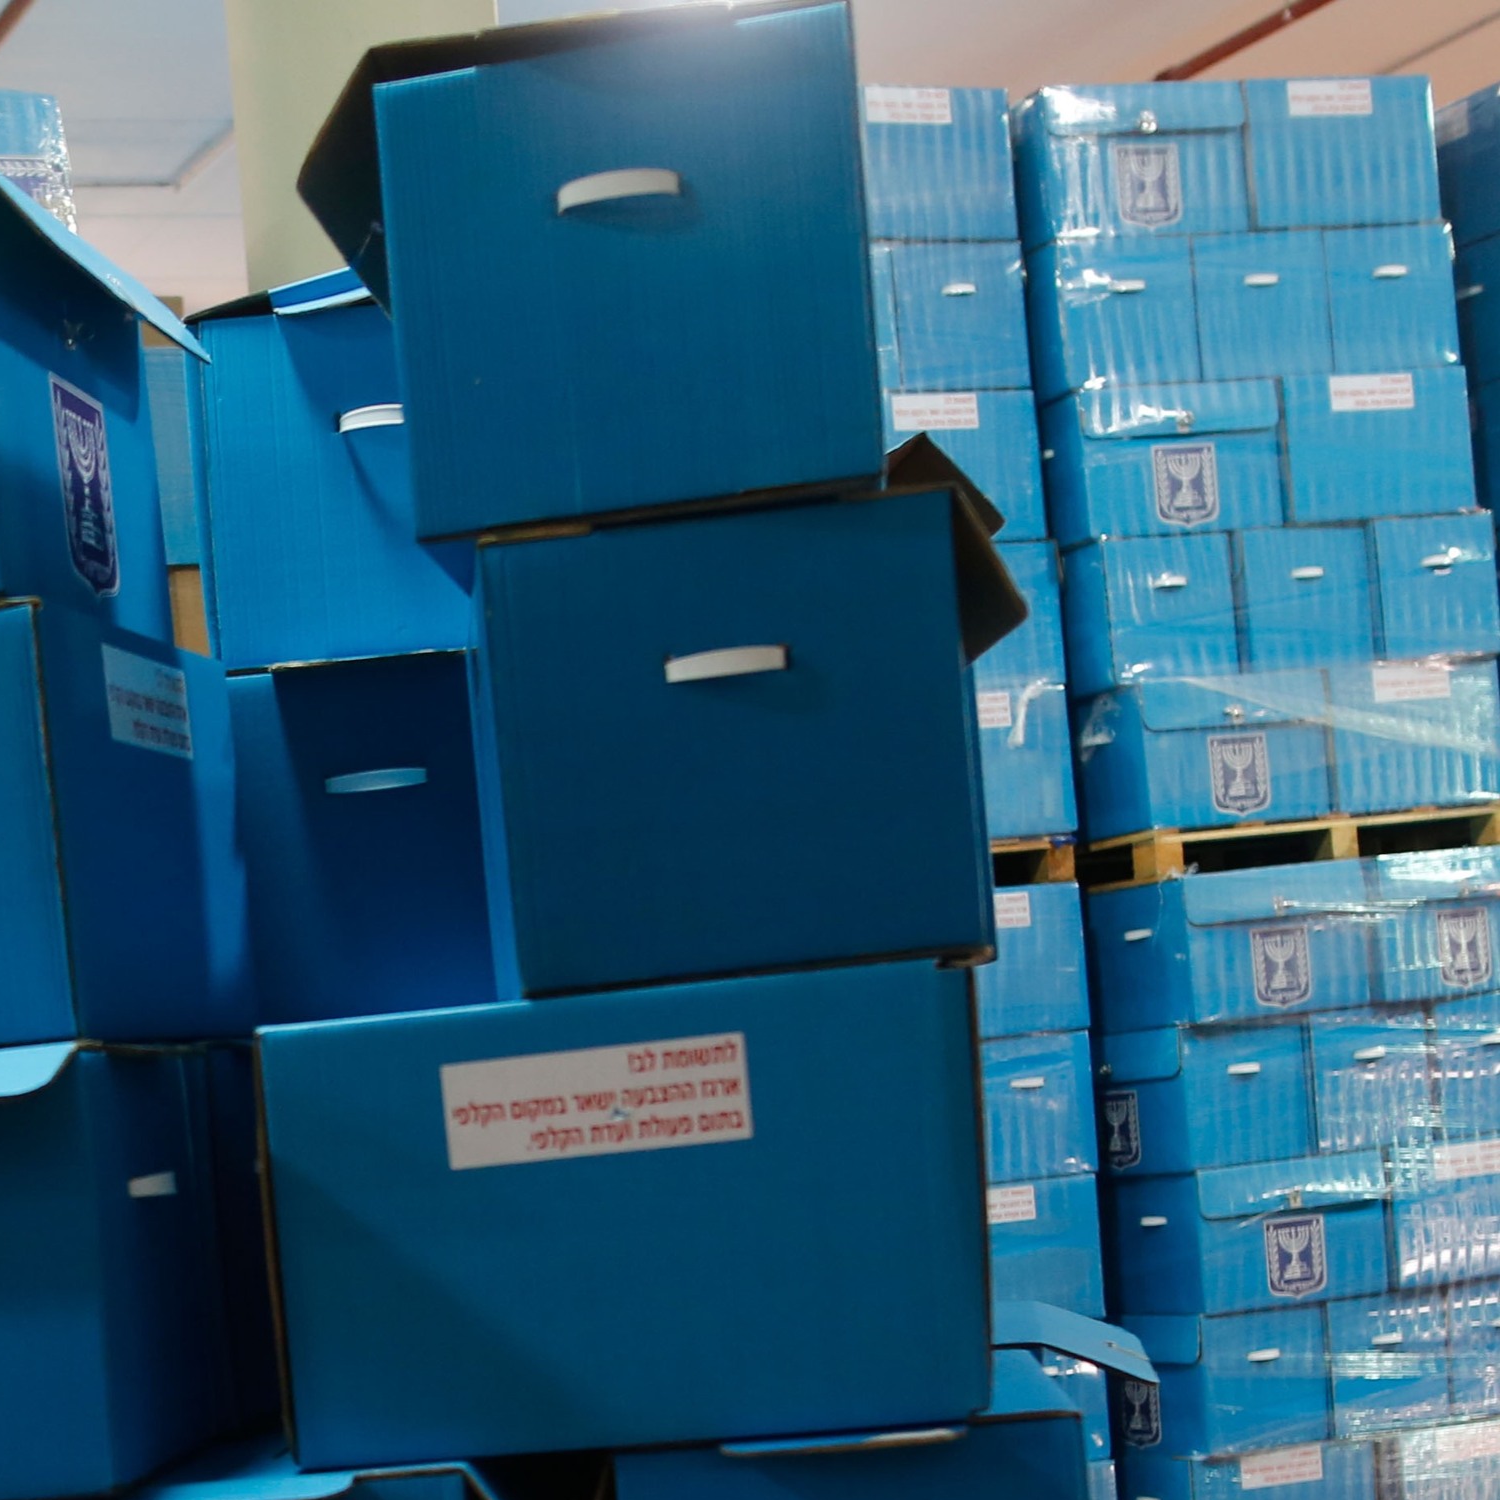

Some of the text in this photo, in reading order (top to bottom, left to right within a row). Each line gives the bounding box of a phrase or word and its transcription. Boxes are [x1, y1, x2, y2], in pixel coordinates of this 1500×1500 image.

[662, 1039, 738, 1070] לתשומת
[453, 1077, 741, 1128] ארגז ההצבעה ישאר במקום הקלפי
[591, 1121, 633, 1141] ועדת
[638, 1113, 693, 1140] פעולת
[698, 1110, 744, 1132] בתום
